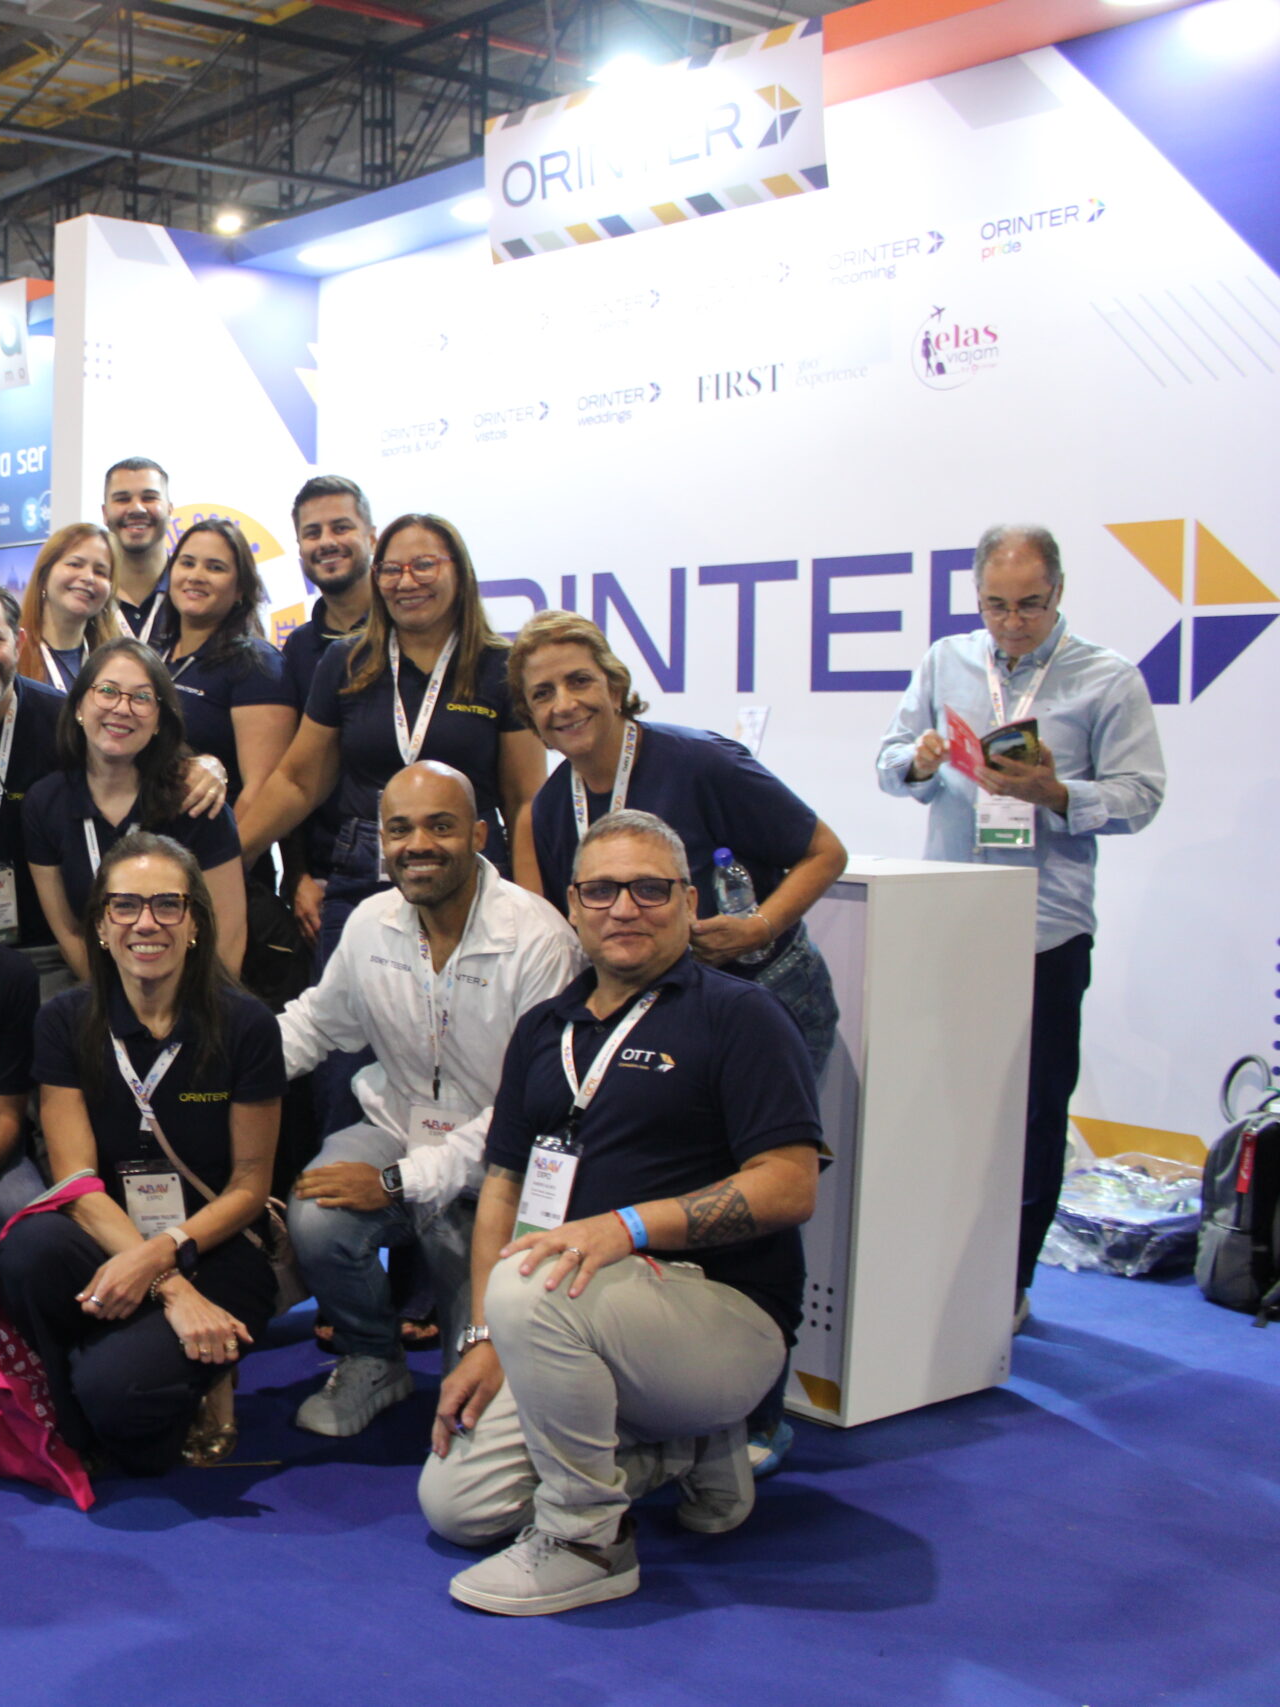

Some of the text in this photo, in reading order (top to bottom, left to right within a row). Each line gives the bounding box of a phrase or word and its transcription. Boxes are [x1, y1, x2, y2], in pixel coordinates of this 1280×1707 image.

[502, 102, 744, 208] ORINER
[980, 204, 1080, 241] ORINTER
[827, 236, 921, 270] ORINTER
[981, 239, 1021, 262] pride
[829, 263, 897, 288] ncoming
[934, 322, 1000, 353] elas
[946, 344, 1001, 368] viajam
[697, 362, 785, 404] FIRST
[795, 363, 869, 389] experience
[577, 387, 645, 411] ORINTER
[473, 405, 536, 429] ORINTER
[578, 407, 633, 428] weddings
[380, 422, 437, 443] ORINTER
[16, 443, 48, 477] ser
[26, 503, 38, 528] 3
[621, 1048, 656, 1063] OTT
[179, 1092, 228, 1102] ORINTER
